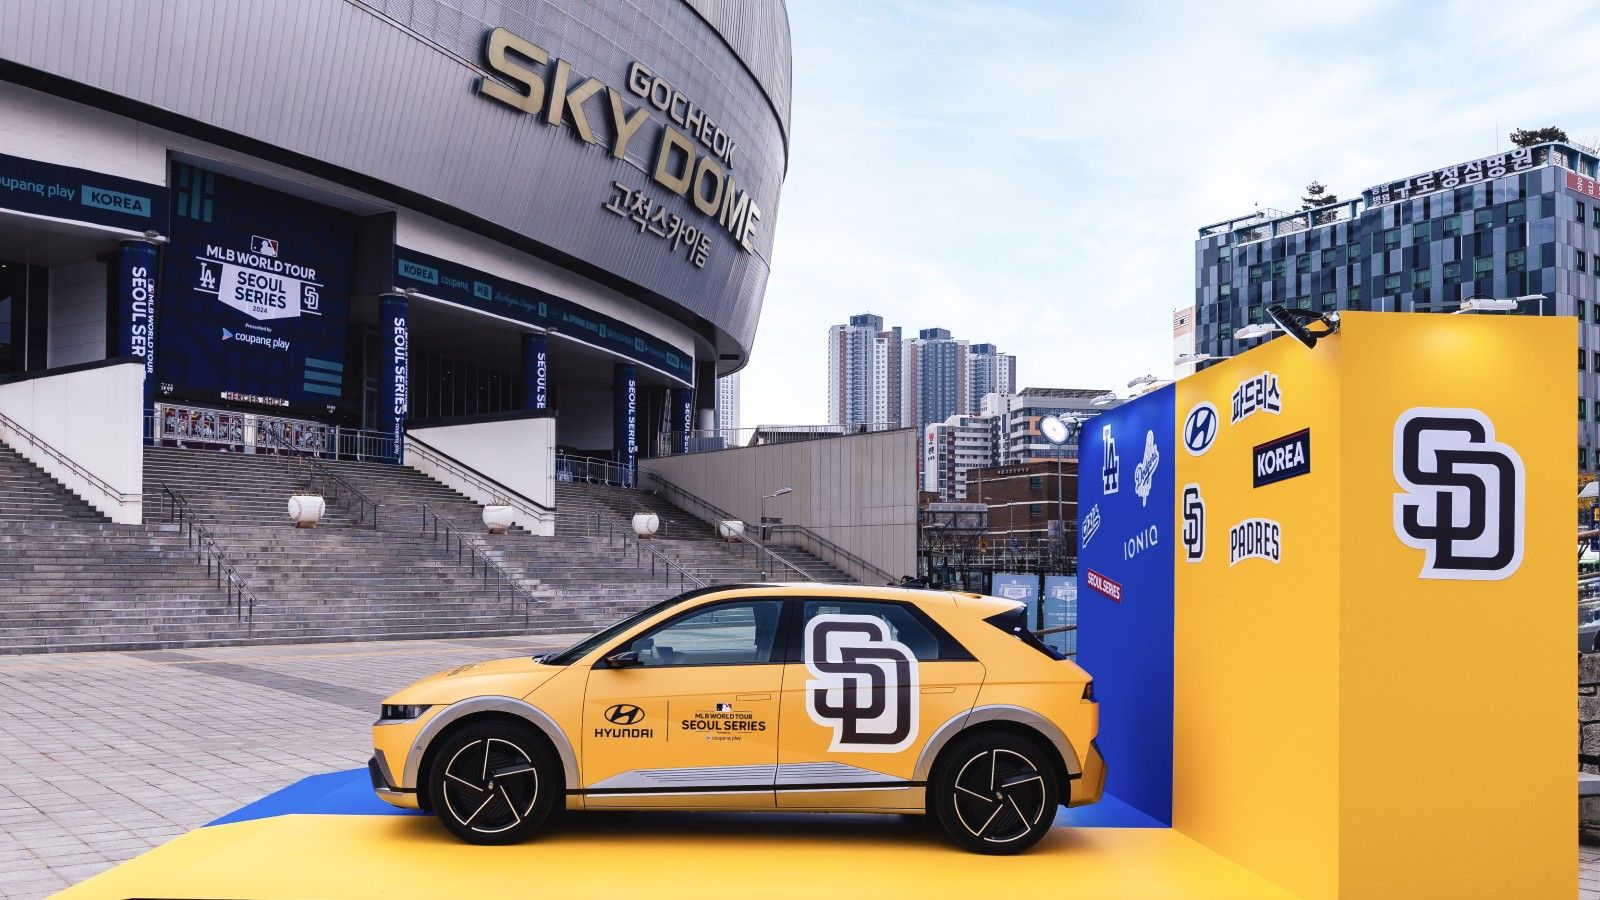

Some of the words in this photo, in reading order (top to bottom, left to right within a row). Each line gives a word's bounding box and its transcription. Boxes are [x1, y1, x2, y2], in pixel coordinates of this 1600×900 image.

[629, 60, 737, 170] GOCHEOK
[479, 26, 651, 160] SKY
[653, 123, 762, 255] DOME
[48, 184, 75, 201] play
[91, 191, 143, 212] KOREA
[1577, 177, 1600, 197] 응급
[604, 180, 711, 269] 고척스카이돔
[199, 262, 215, 289] LA
[206, 244, 235, 261] MLB
[237, 251, 283, 273] WORLD
[284, 263, 316, 281] TOUR
[404, 263, 434, 281] KOREA
[131, 266, 147, 322] SEOUL
[234, 286, 287, 309] SERIES
[237, 271, 287, 294] SEOUL
[147, 294, 155, 314] MLB
[252, 305, 268, 313] 2024
[131, 324, 147, 357] SER
[147, 315, 155, 349] WORLD
[235, 332, 272, 349] coupang
[272, 337, 290, 351] play
[394, 317, 405, 363] SEOUL
[147, 350, 155, 374] TOUR
[537, 352, 546, 393] SEOUL
[394, 365, 405, 415] SERIES
[537, 394, 546, 409] SE
[628, 380, 636, 414] SEOUL
[1231, 373, 1281, 424] 파드리스
[628, 416, 636, 454] SERIES
[1257, 441, 1305, 478] KOREA
[1402, 416, 1517, 571] SD
[1183, 487, 1204, 559] SD
[1124, 525, 1158, 561] IONIQ
[1230, 520, 1280, 564] PADRES
[1087, 571, 1104, 591] SEOUL
[1102, 579, 1121, 600] SERIES
[812, 621, 911, 745] SD
[595, 728, 653, 738] HYUNDAI
[681, 719, 722, 731] SEOUL
[723, 720, 766, 732] SERIES
